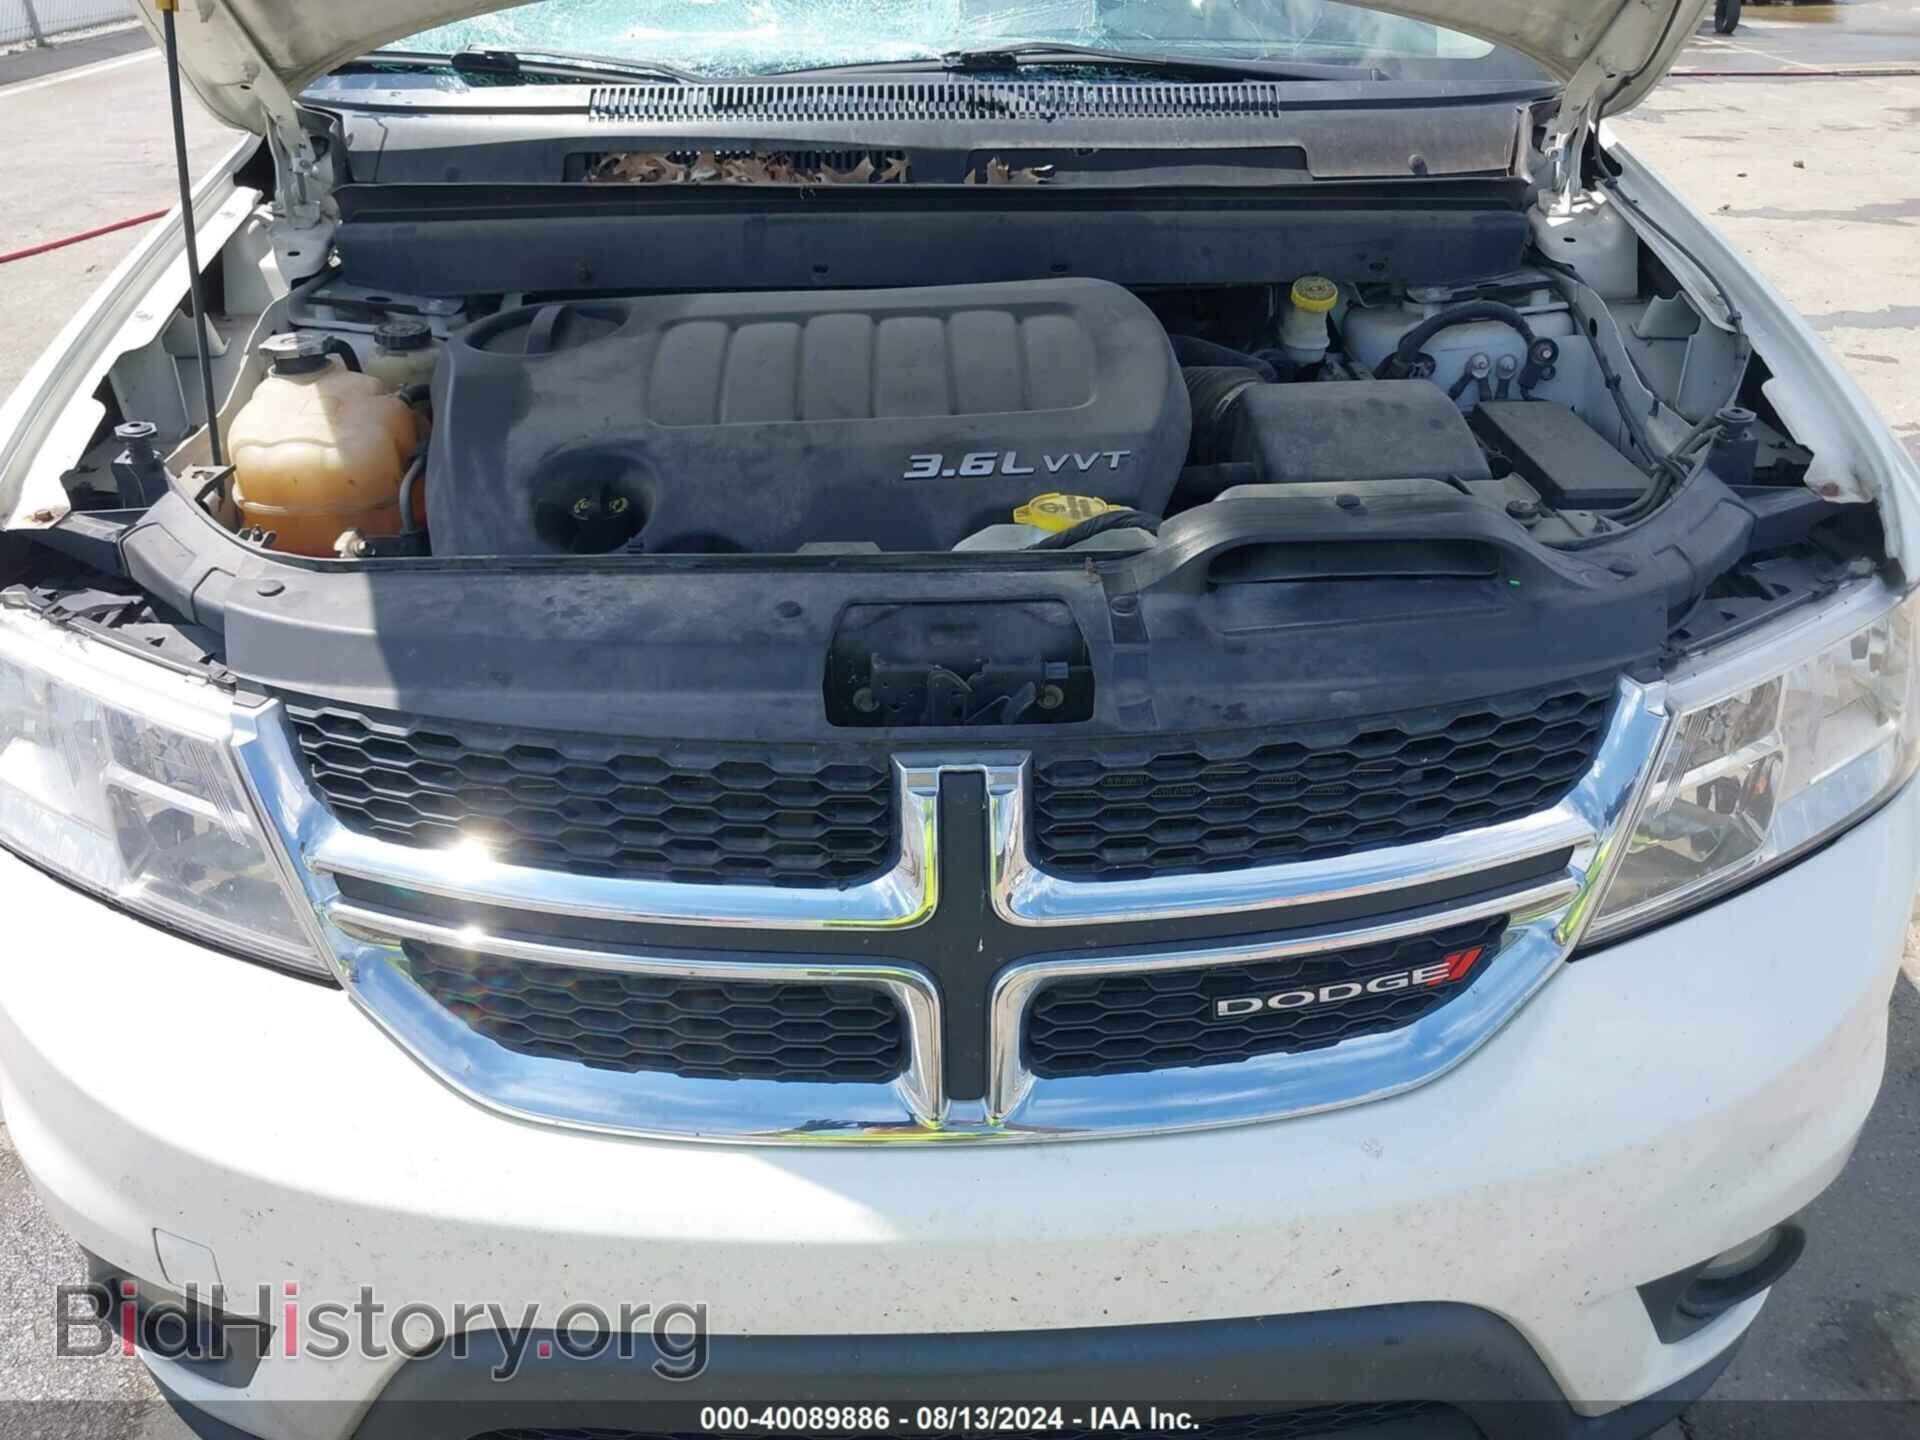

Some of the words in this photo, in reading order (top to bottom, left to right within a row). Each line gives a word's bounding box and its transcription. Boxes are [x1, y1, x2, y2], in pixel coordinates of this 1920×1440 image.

[903, 451, 1035, 478] 3.6L
[1043, 449, 1131, 473] VVT
[1217, 962, 1451, 1017] DODGE
